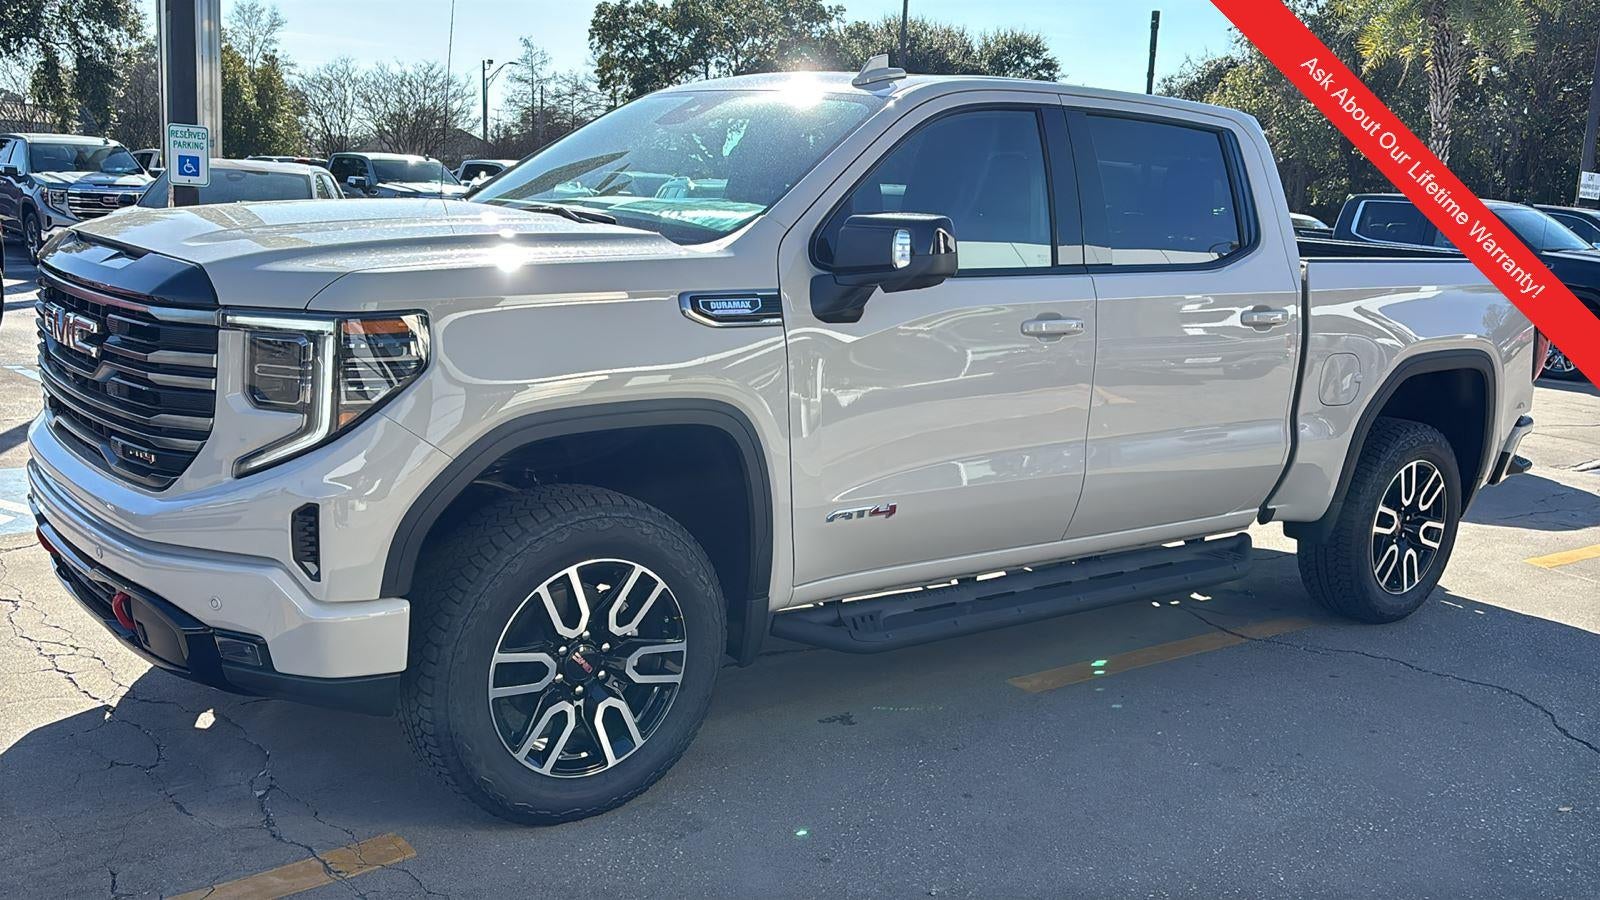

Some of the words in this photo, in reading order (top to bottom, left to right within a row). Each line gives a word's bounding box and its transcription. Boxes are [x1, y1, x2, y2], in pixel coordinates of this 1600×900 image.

[170, 129, 207, 140] RESERVED
[172, 139, 205, 151] PARKING
[710, 300, 752, 310] DURAMAX
[44, 301, 98, 358] GMC
[825, 502, 897, 523] AT4
